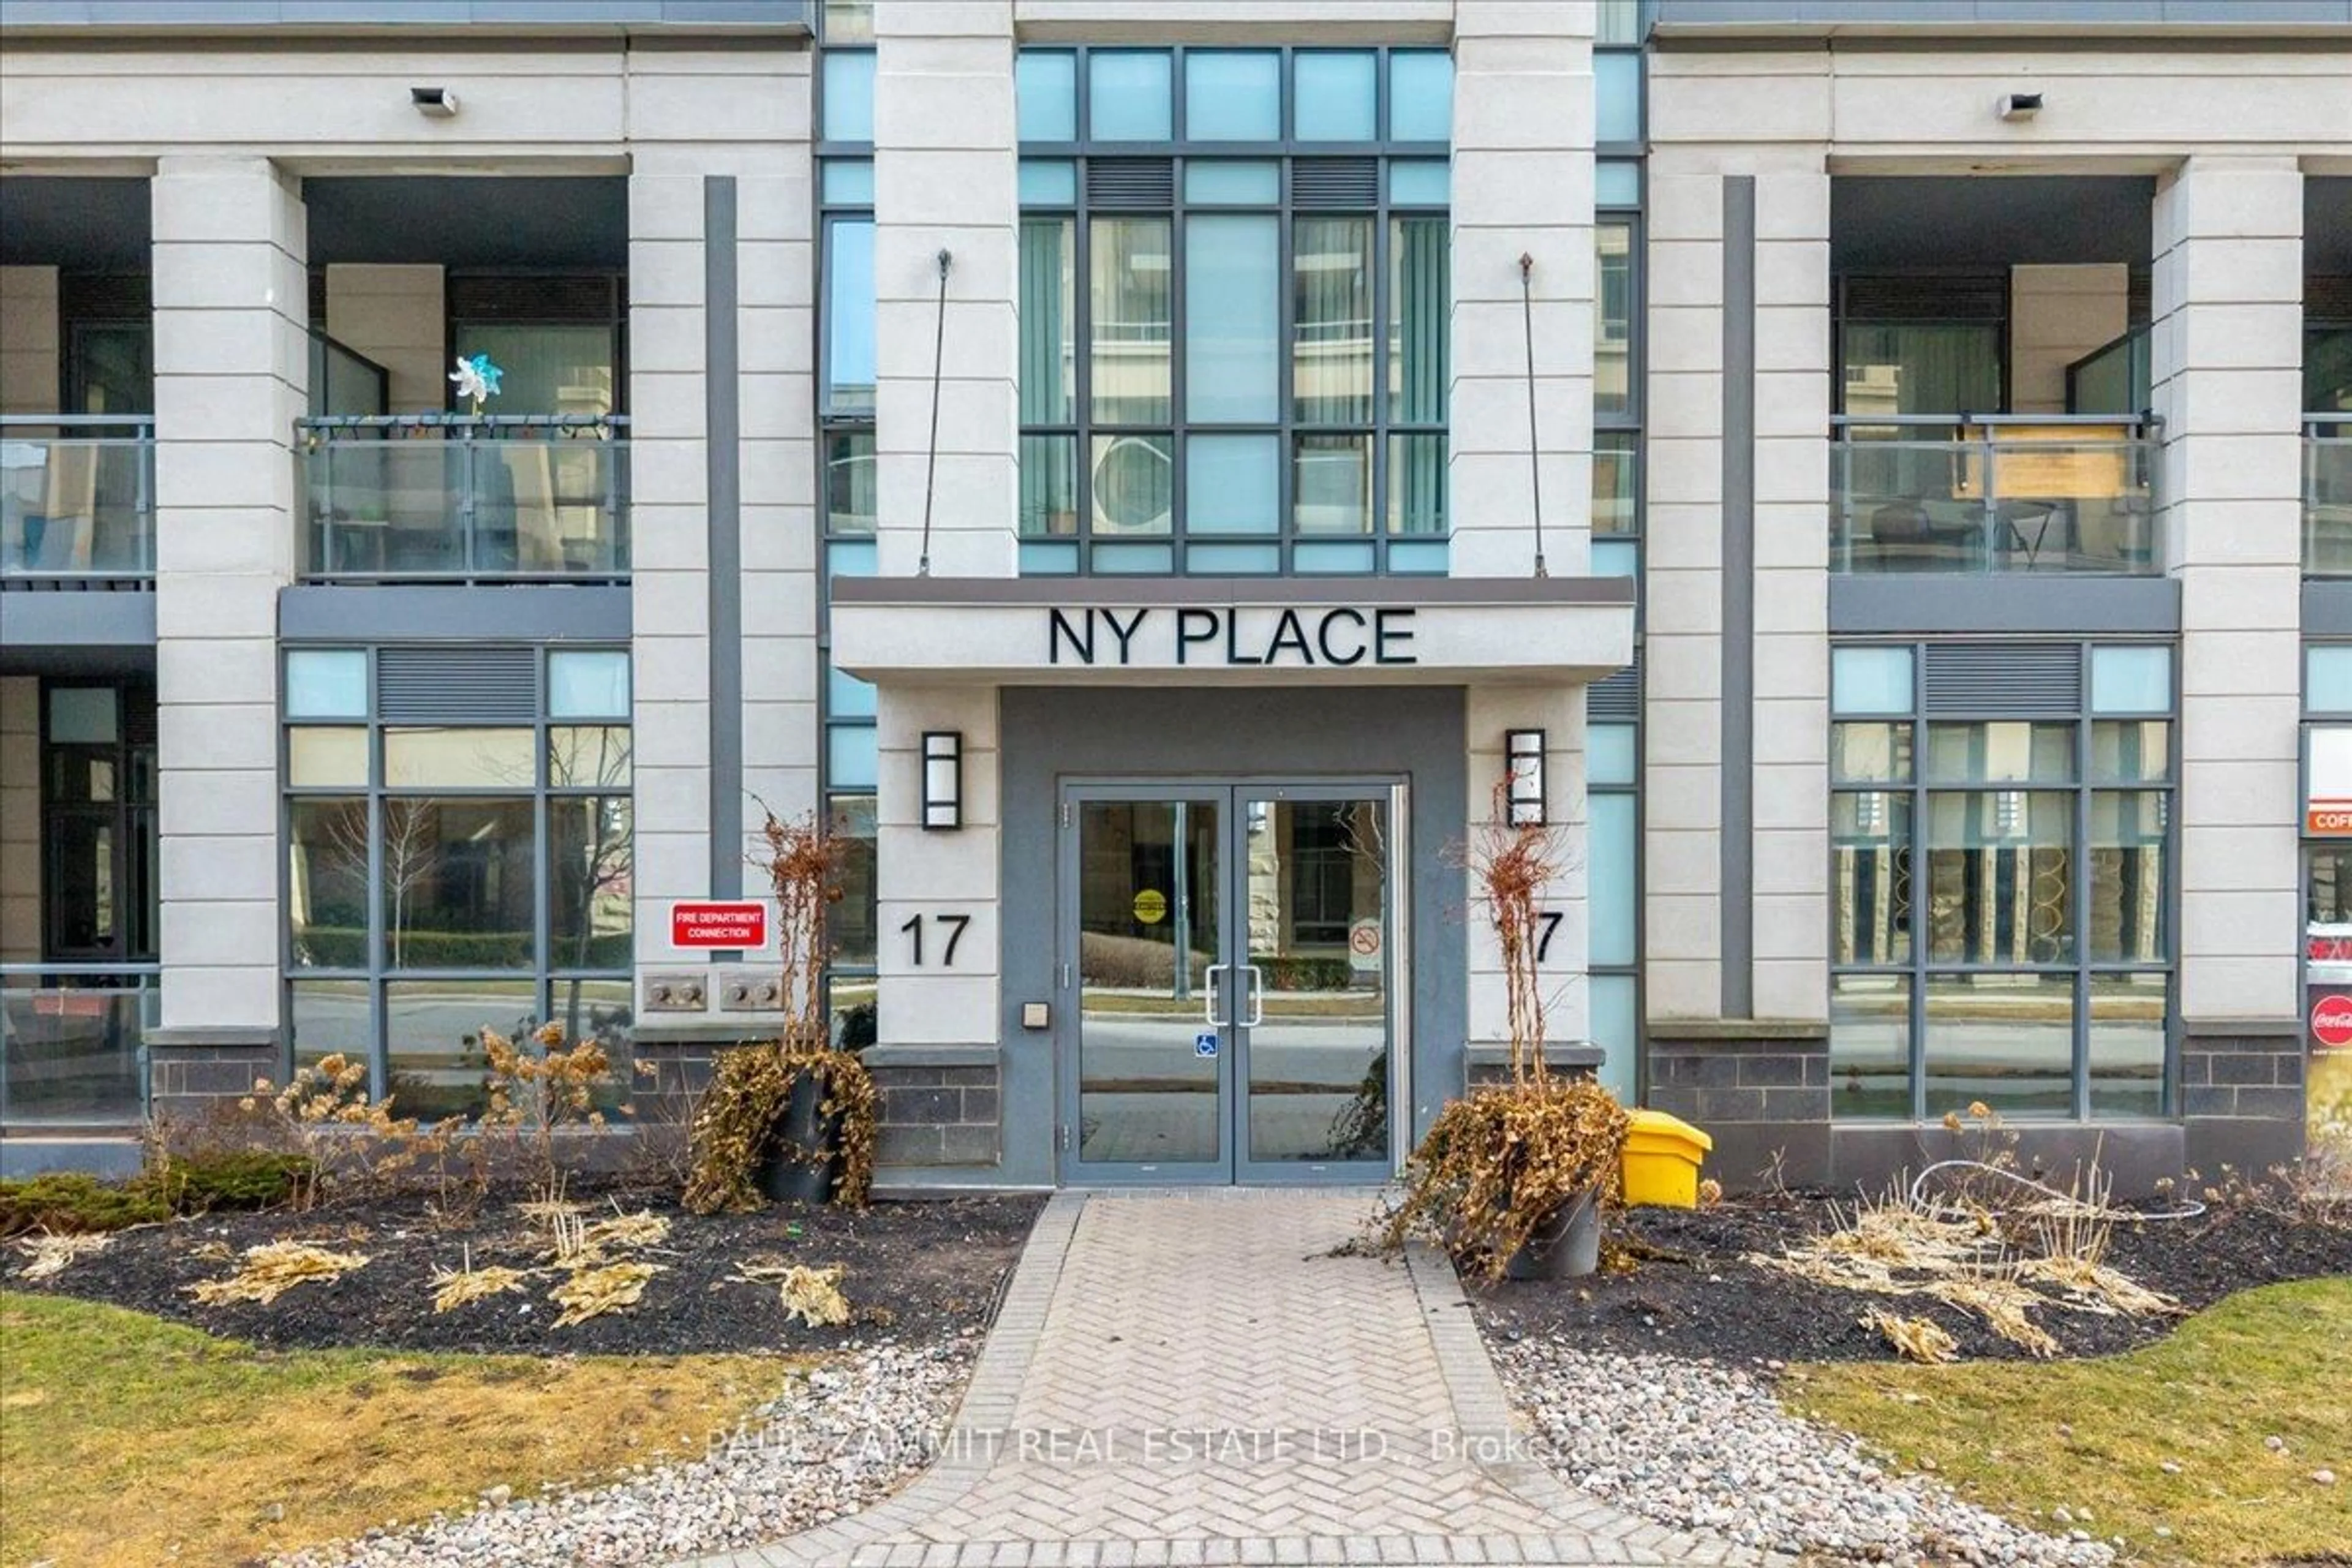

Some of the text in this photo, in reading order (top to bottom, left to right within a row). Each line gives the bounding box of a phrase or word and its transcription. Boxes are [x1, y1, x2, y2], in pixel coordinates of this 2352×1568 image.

[1050, 608, 1417, 664] NY PLACE
[676, 912, 761, 923] FIRE DEPARTMENT
[688, 927, 750, 938] CONNECTION
[902, 913, 970, 966] 17
